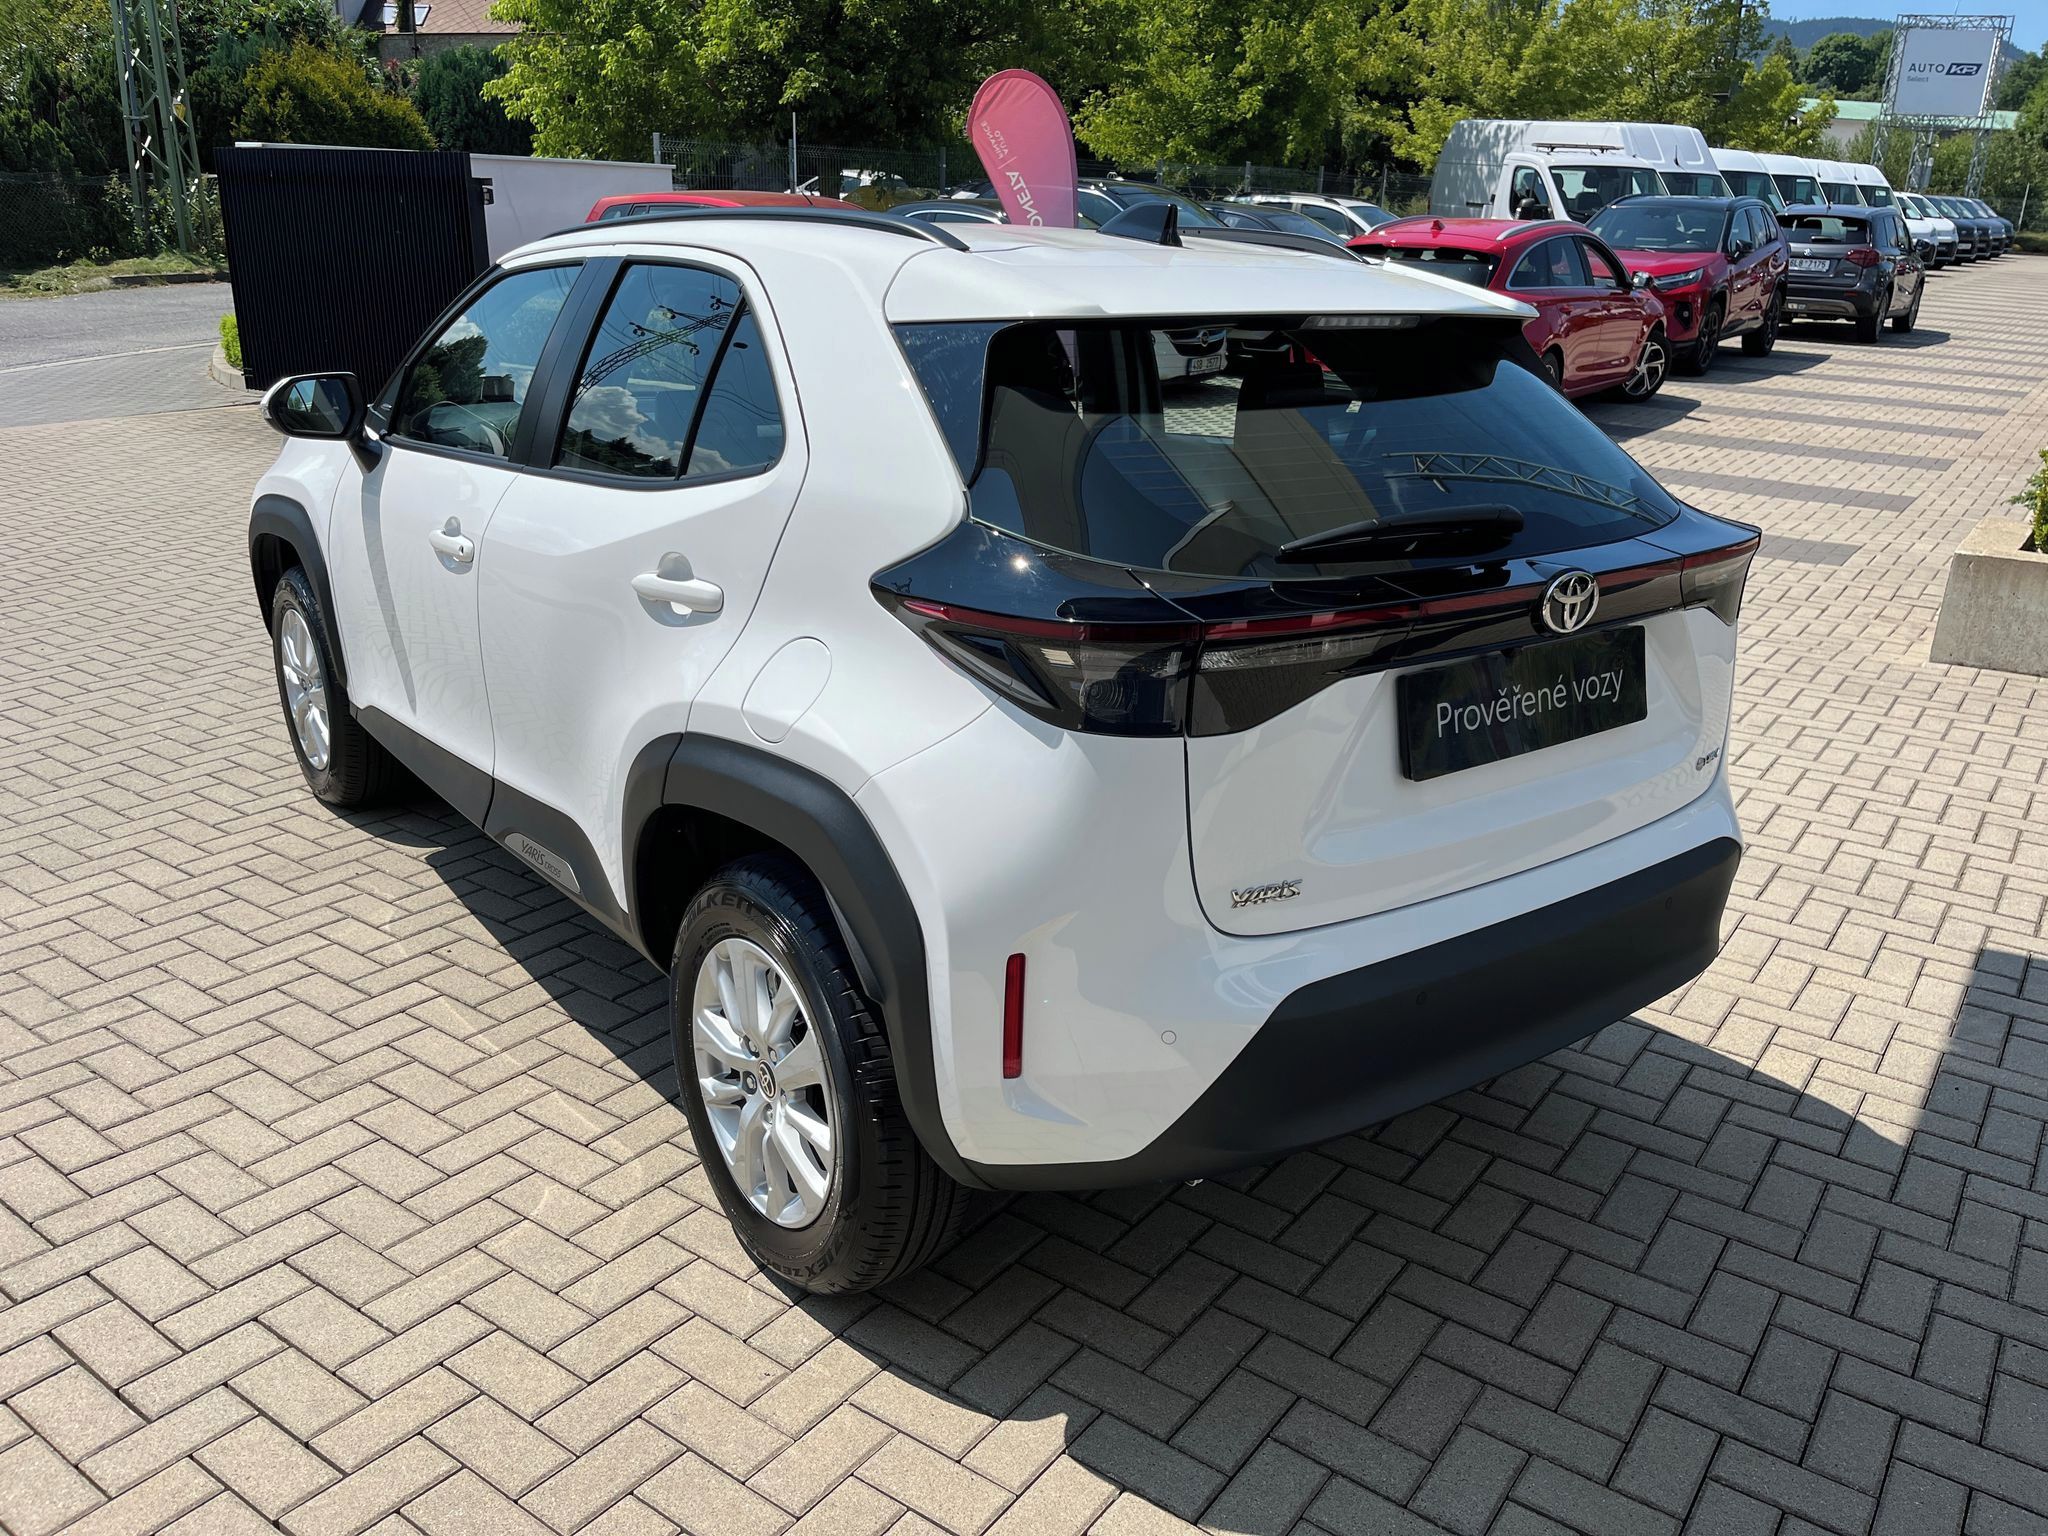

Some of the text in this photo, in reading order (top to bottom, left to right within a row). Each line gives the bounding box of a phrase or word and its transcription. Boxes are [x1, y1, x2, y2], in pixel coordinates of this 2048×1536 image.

[1908, 63, 1945, 74] AUTO
[1906, 75, 1929, 83] Select
[1436, 668, 1624, 738] Prověřené vozy
[544, 861, 562, 878] CROSS
